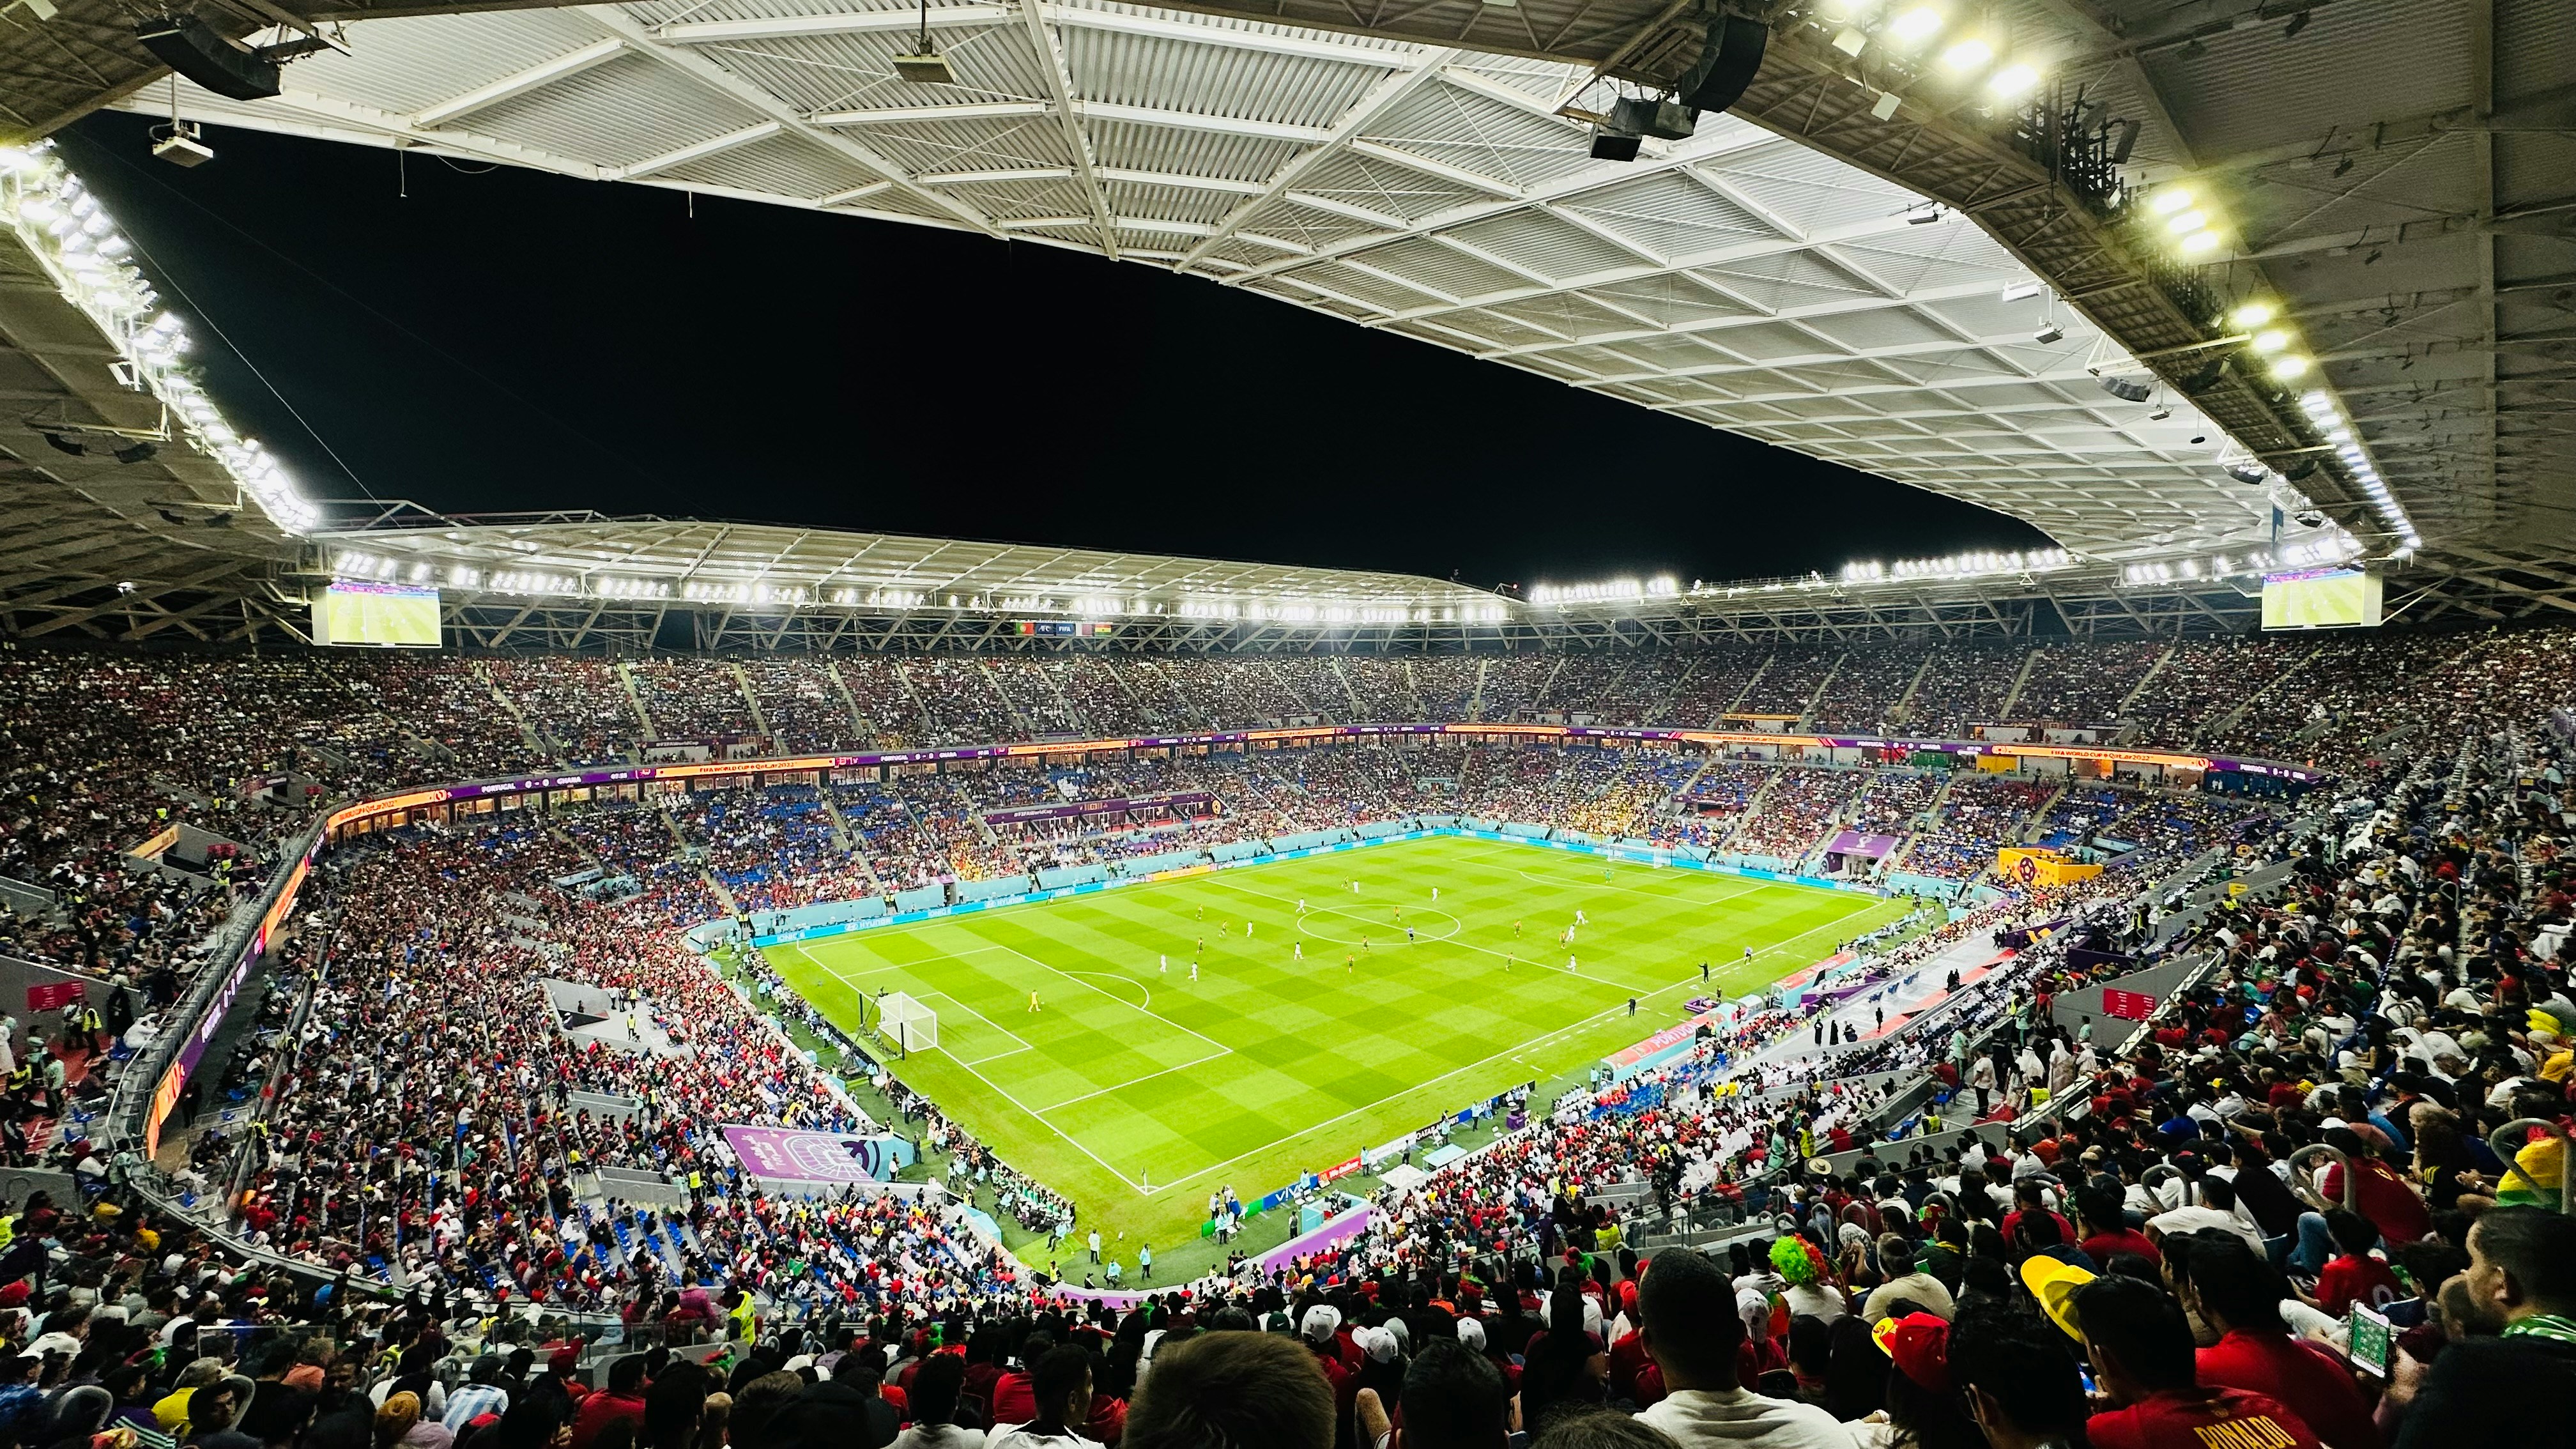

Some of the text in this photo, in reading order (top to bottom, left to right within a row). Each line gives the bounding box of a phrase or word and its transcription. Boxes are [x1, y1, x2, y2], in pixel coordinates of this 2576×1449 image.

[481, 783, 516, 793] PORTUGAL
[525, 780, 532, 788] 0
[542, 778, 549, 787] 0
[860, 917, 893, 928] HYUNDAI
[1416, 1126, 1436, 1140] QATAR
[2193, 1414, 2297, 1449] RONALDO
